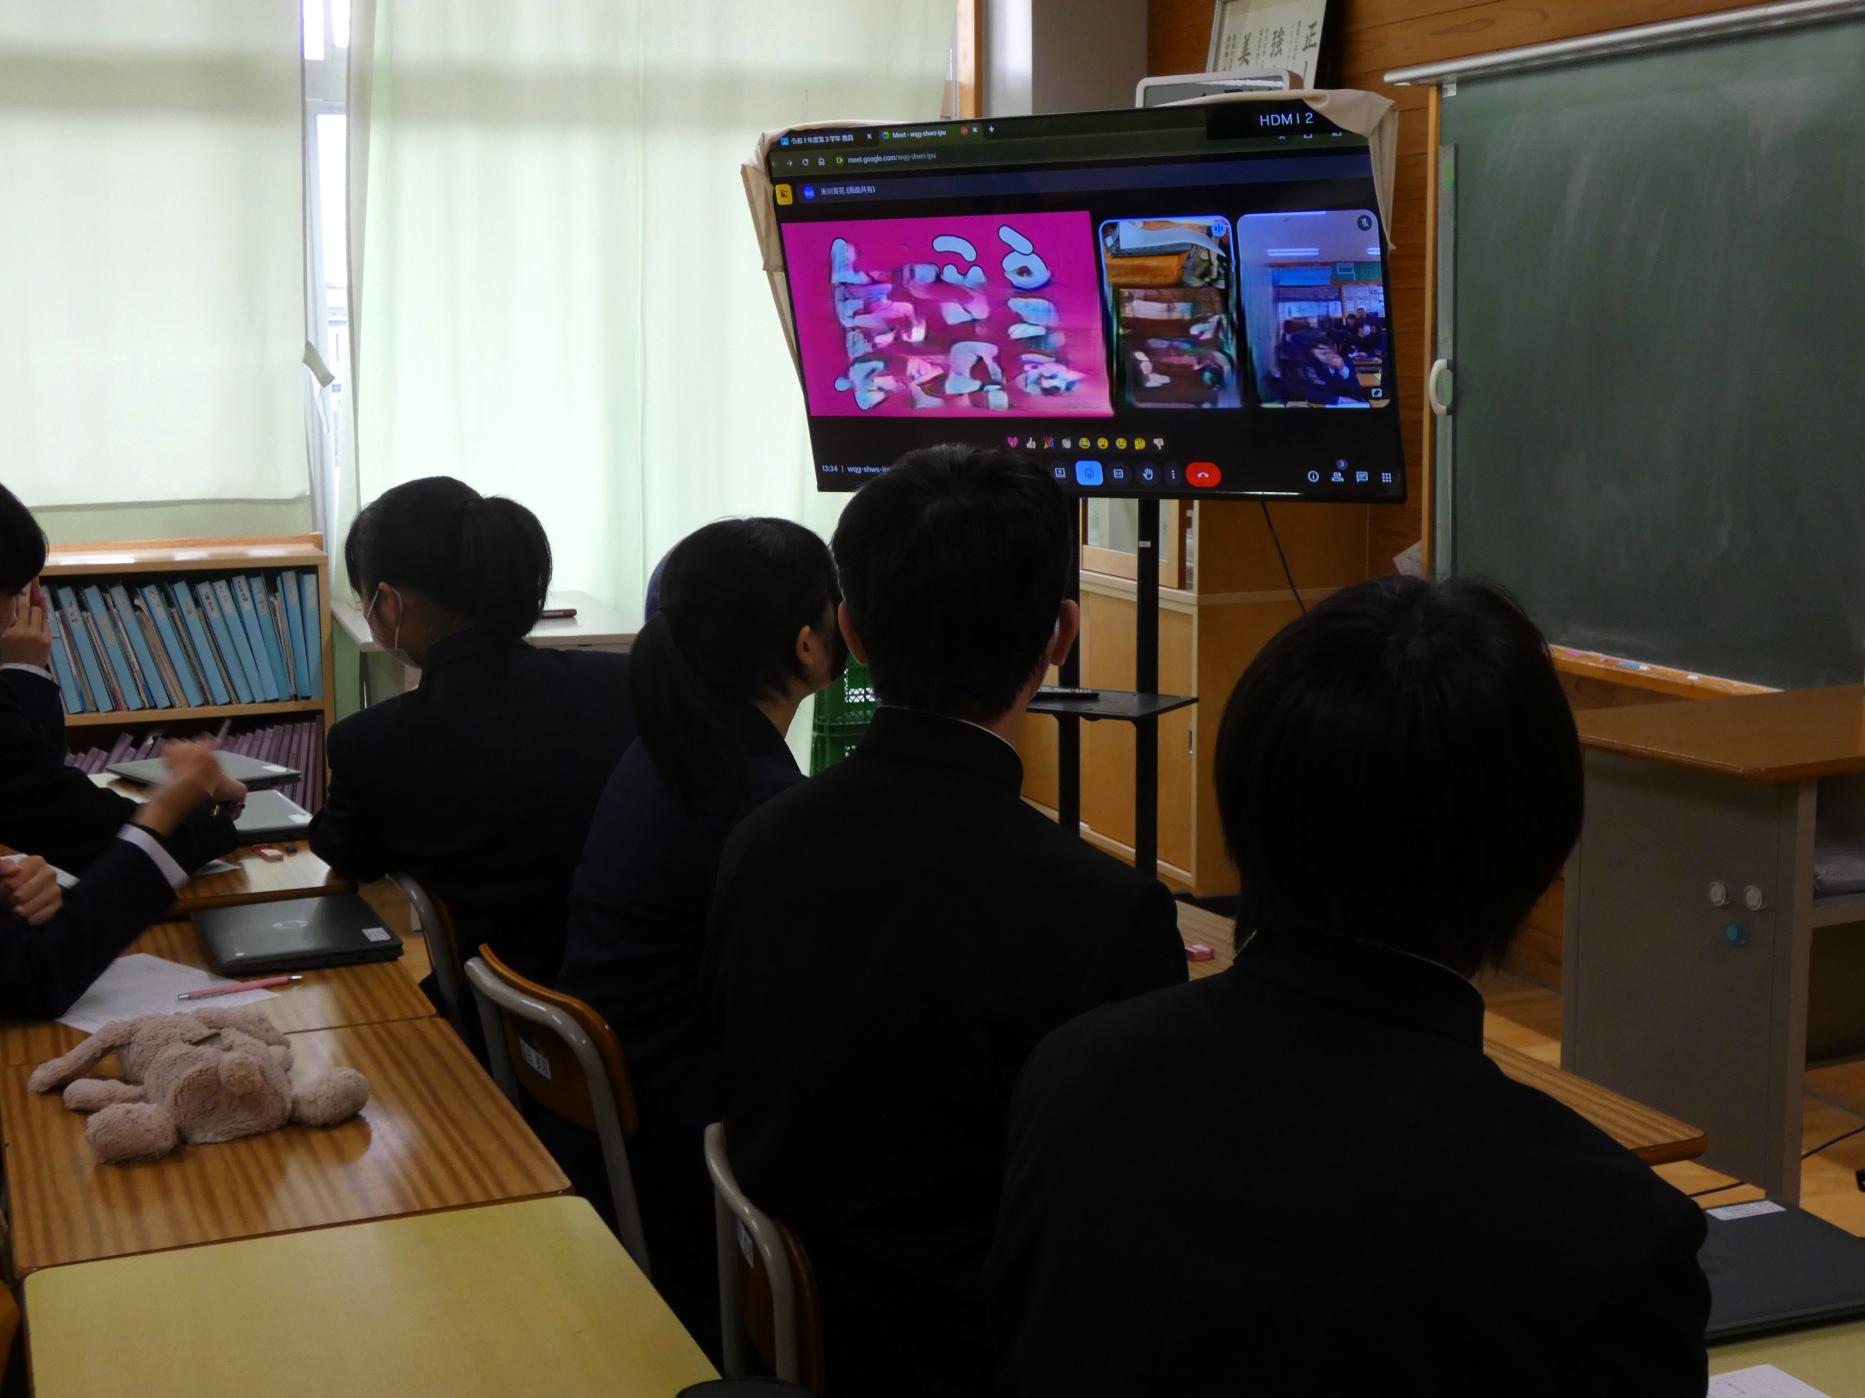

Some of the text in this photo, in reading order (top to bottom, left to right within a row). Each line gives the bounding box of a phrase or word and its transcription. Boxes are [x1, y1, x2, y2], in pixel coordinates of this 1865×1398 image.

[1259, 112, 1314, 127] HDMI 2
[822, 464, 838, 472] 13:34
